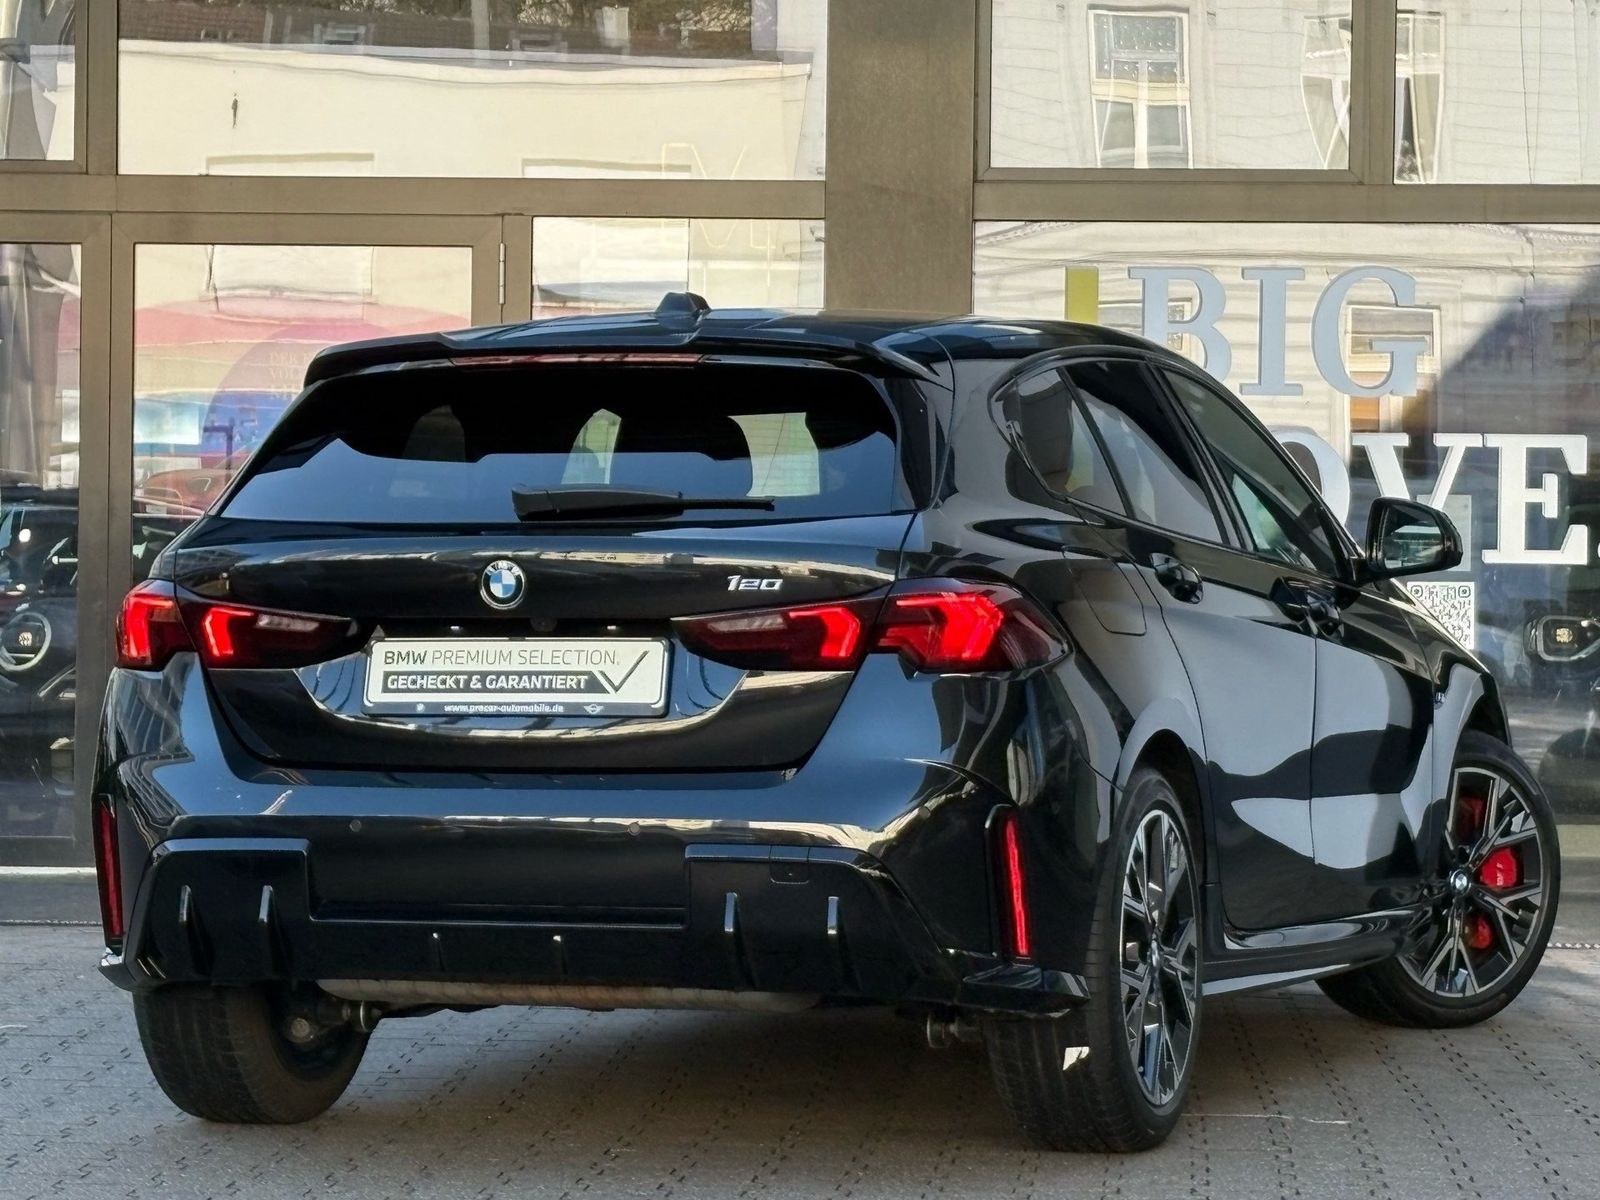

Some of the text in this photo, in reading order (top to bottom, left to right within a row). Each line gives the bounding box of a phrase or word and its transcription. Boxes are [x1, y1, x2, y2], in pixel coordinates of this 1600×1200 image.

[1127, 265, 1428, 398] BIG
[726, 575, 784, 591] 120
[384, 650, 427, 665] BMW
[431, 649, 512, 665] PREMIUM
[387, 674, 588, 689] GECHECKT & GARANTIERT
